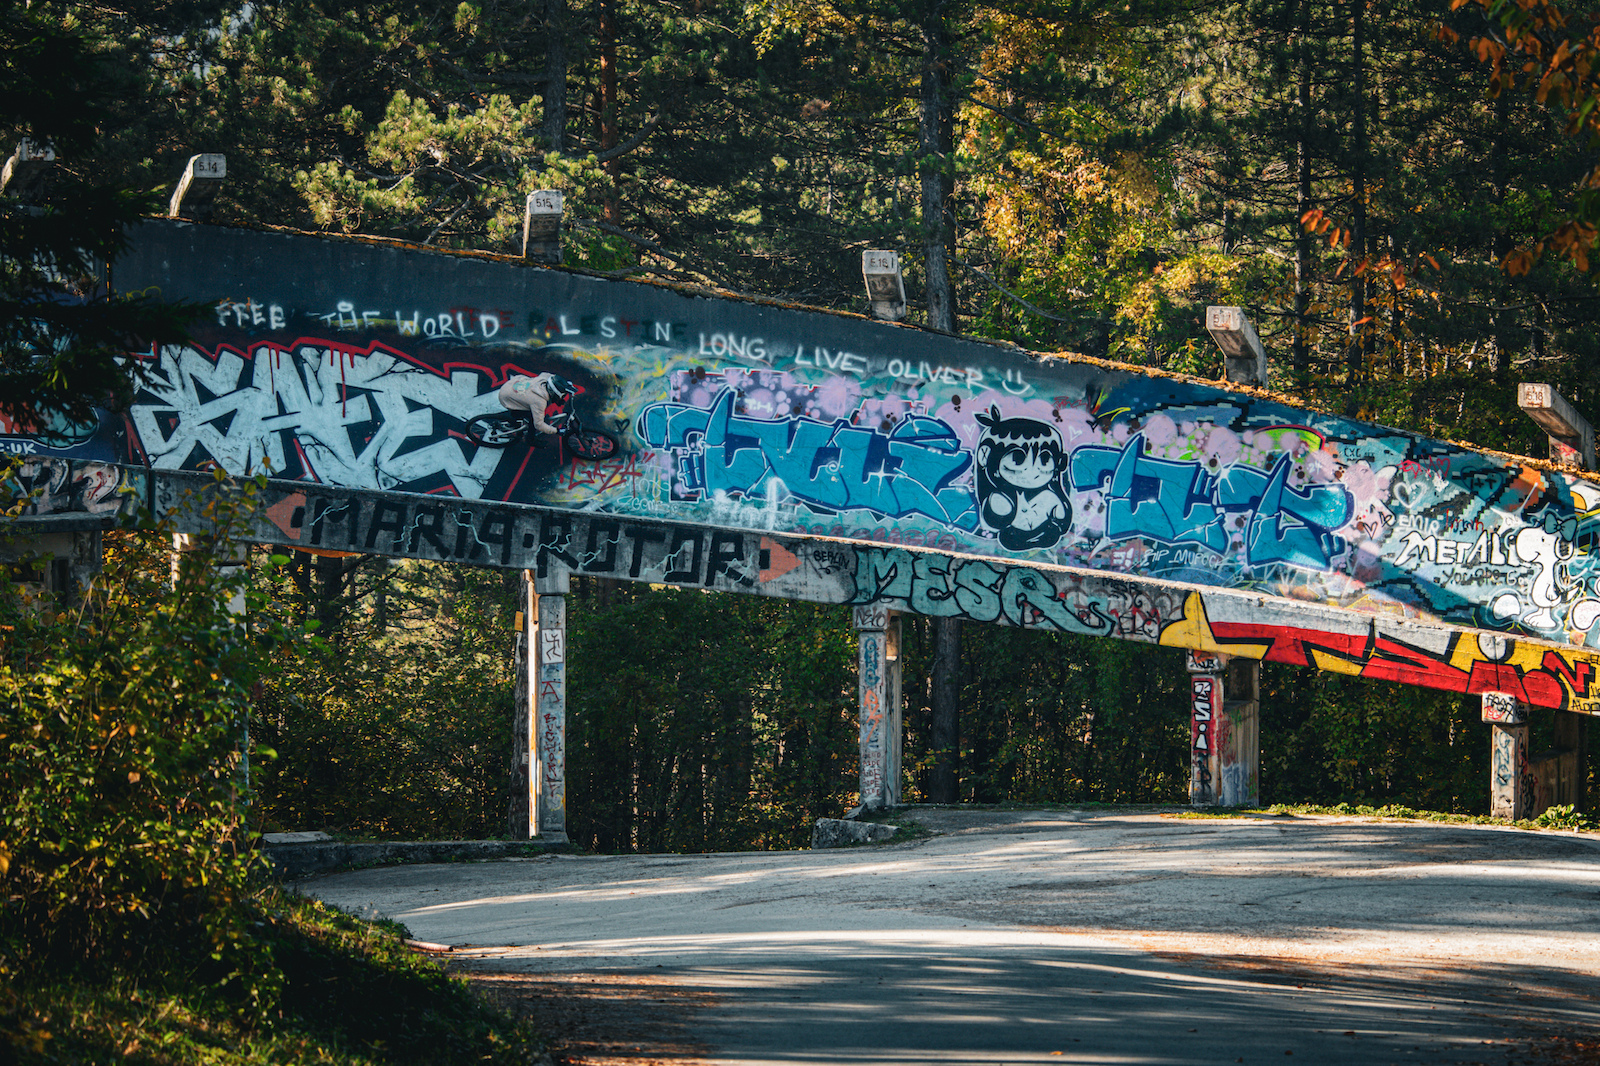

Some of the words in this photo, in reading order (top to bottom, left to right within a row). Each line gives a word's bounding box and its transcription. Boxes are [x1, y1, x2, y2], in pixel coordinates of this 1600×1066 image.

[536, 198, 551, 208] 5.15
[396, 309, 499, 338] WORLD
[699, 332, 765, 360] LONG
[796, 343, 867, 373] LIVE
[888, 358, 996, 392] OLIVER
[1399, 514, 1441, 540] EMIR
